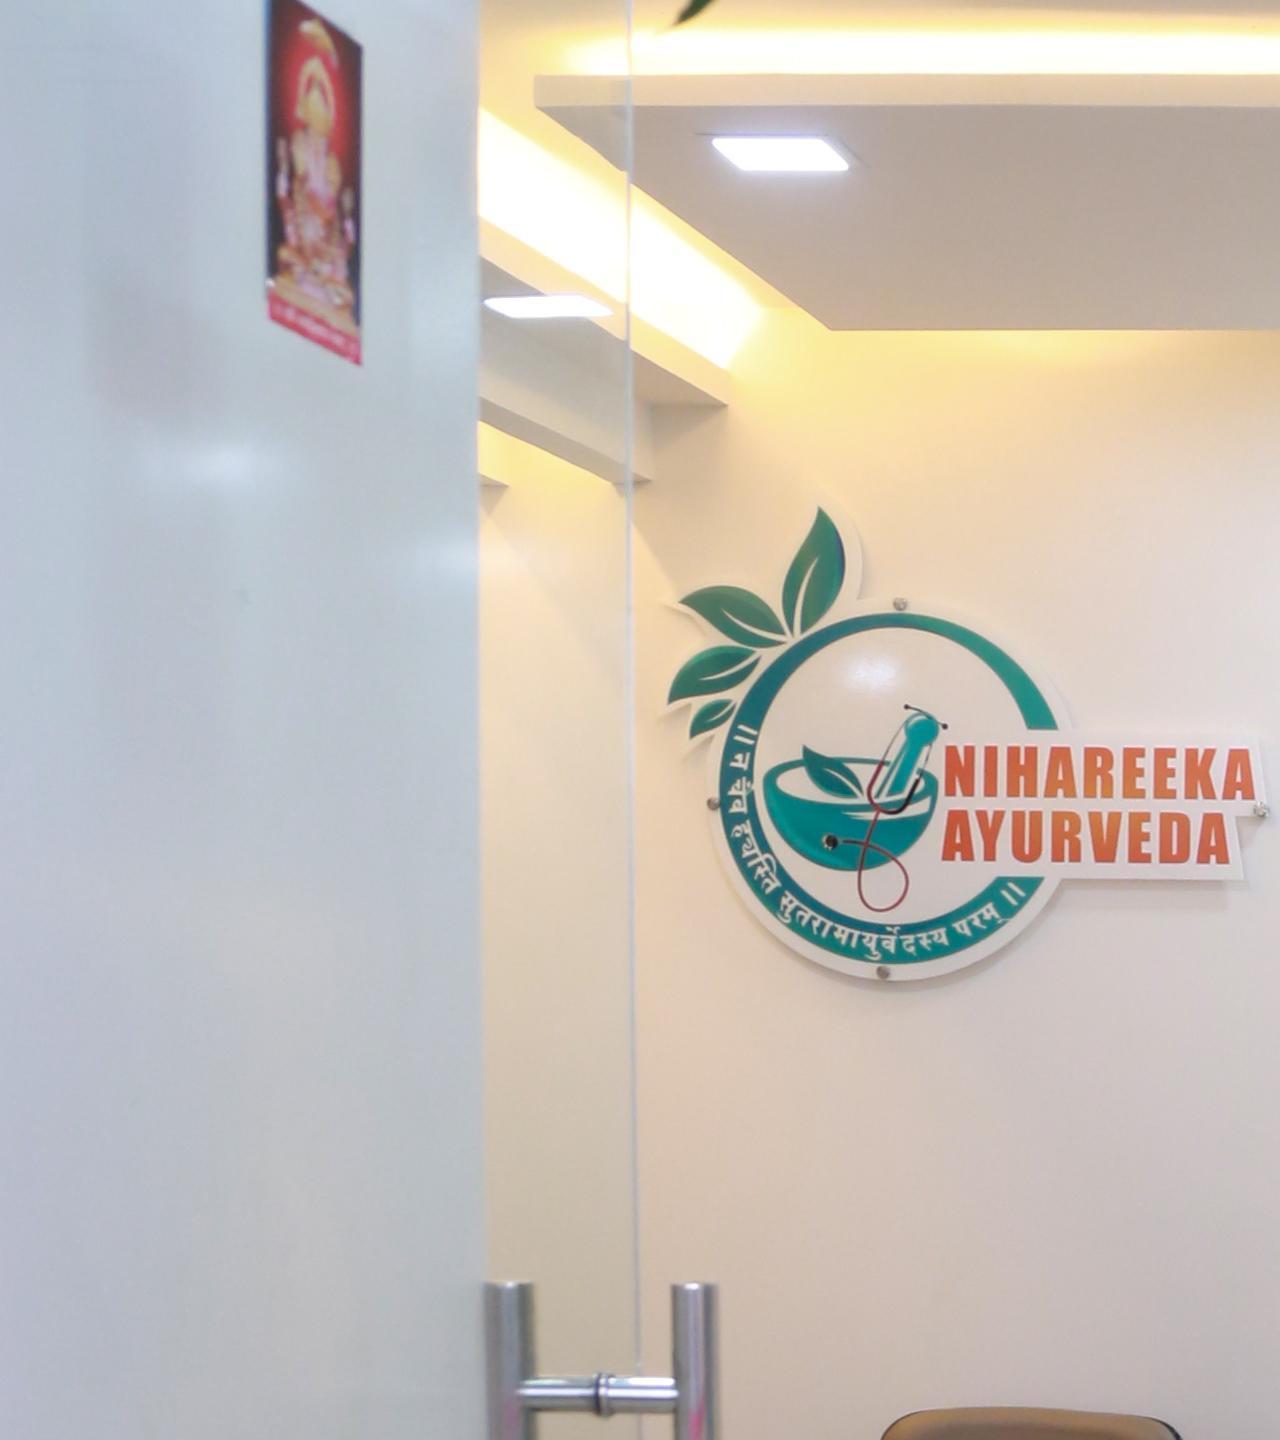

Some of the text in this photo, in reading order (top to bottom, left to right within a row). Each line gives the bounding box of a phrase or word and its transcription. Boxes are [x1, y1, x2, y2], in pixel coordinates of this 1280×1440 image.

[729, 752, 751, 771] न
[944, 745, 1256, 800] NIHAREEKA
[727, 776, 755, 814] चैव
[941, 809, 1230, 864] AYURVEDA
